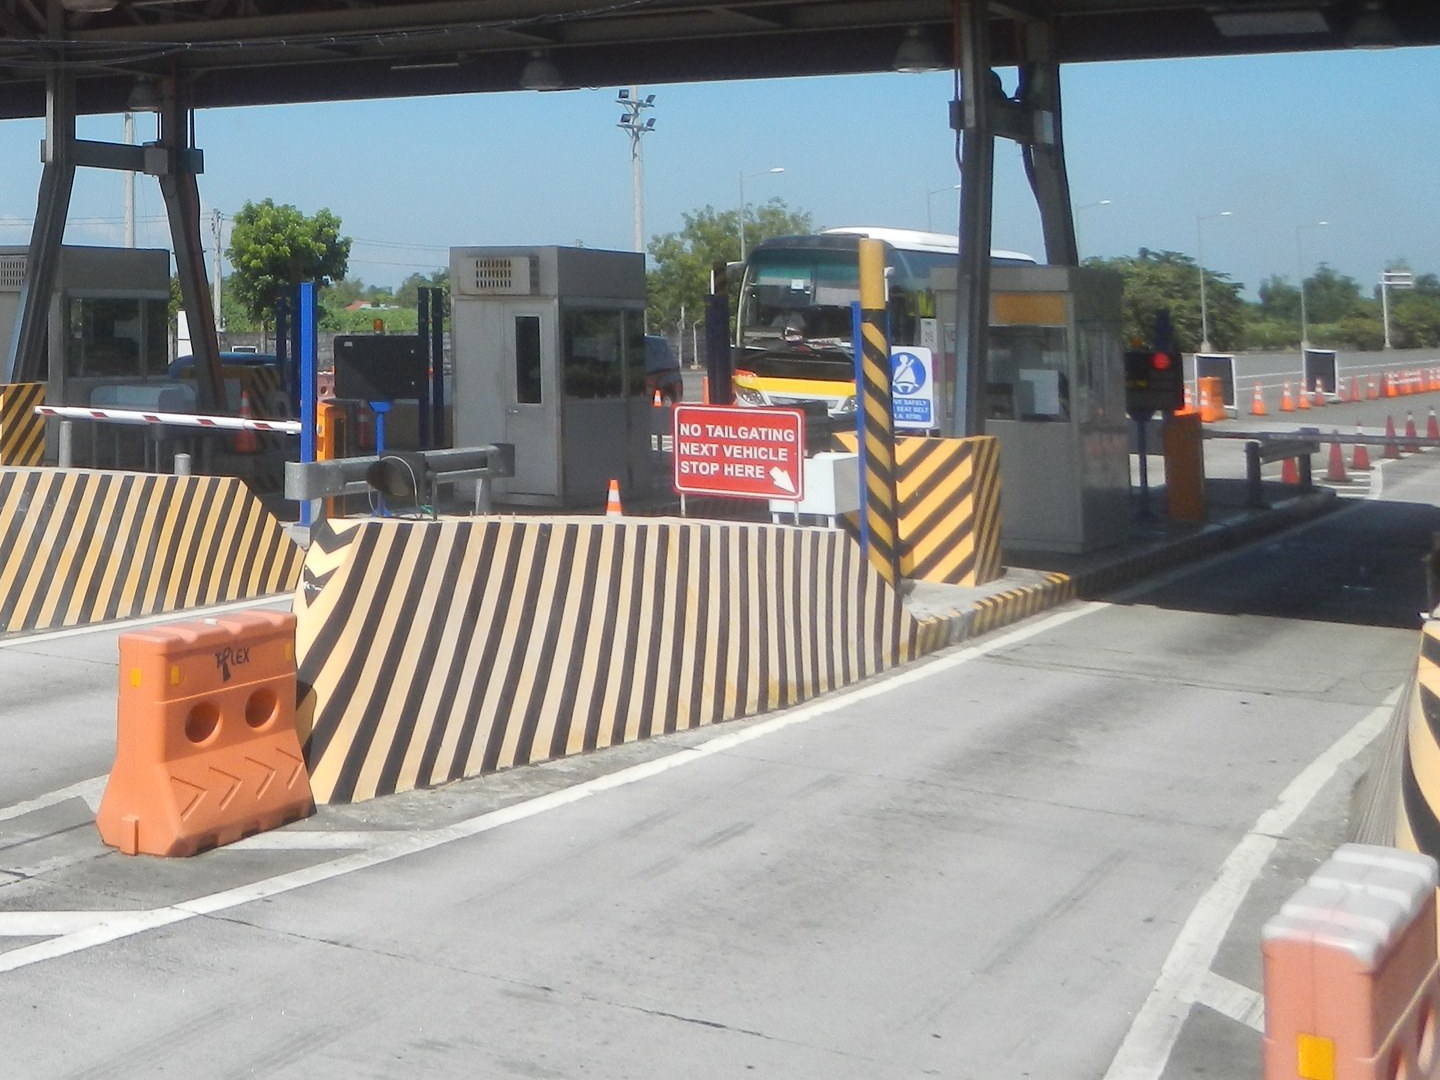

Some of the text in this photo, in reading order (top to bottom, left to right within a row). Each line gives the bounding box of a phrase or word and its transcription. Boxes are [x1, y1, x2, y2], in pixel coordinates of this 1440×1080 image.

[680, 423, 795, 442] NO TAILGATING
[680, 442, 788, 461] NEXT VEHICLE
[680, 461, 765, 479] STOP HERE
